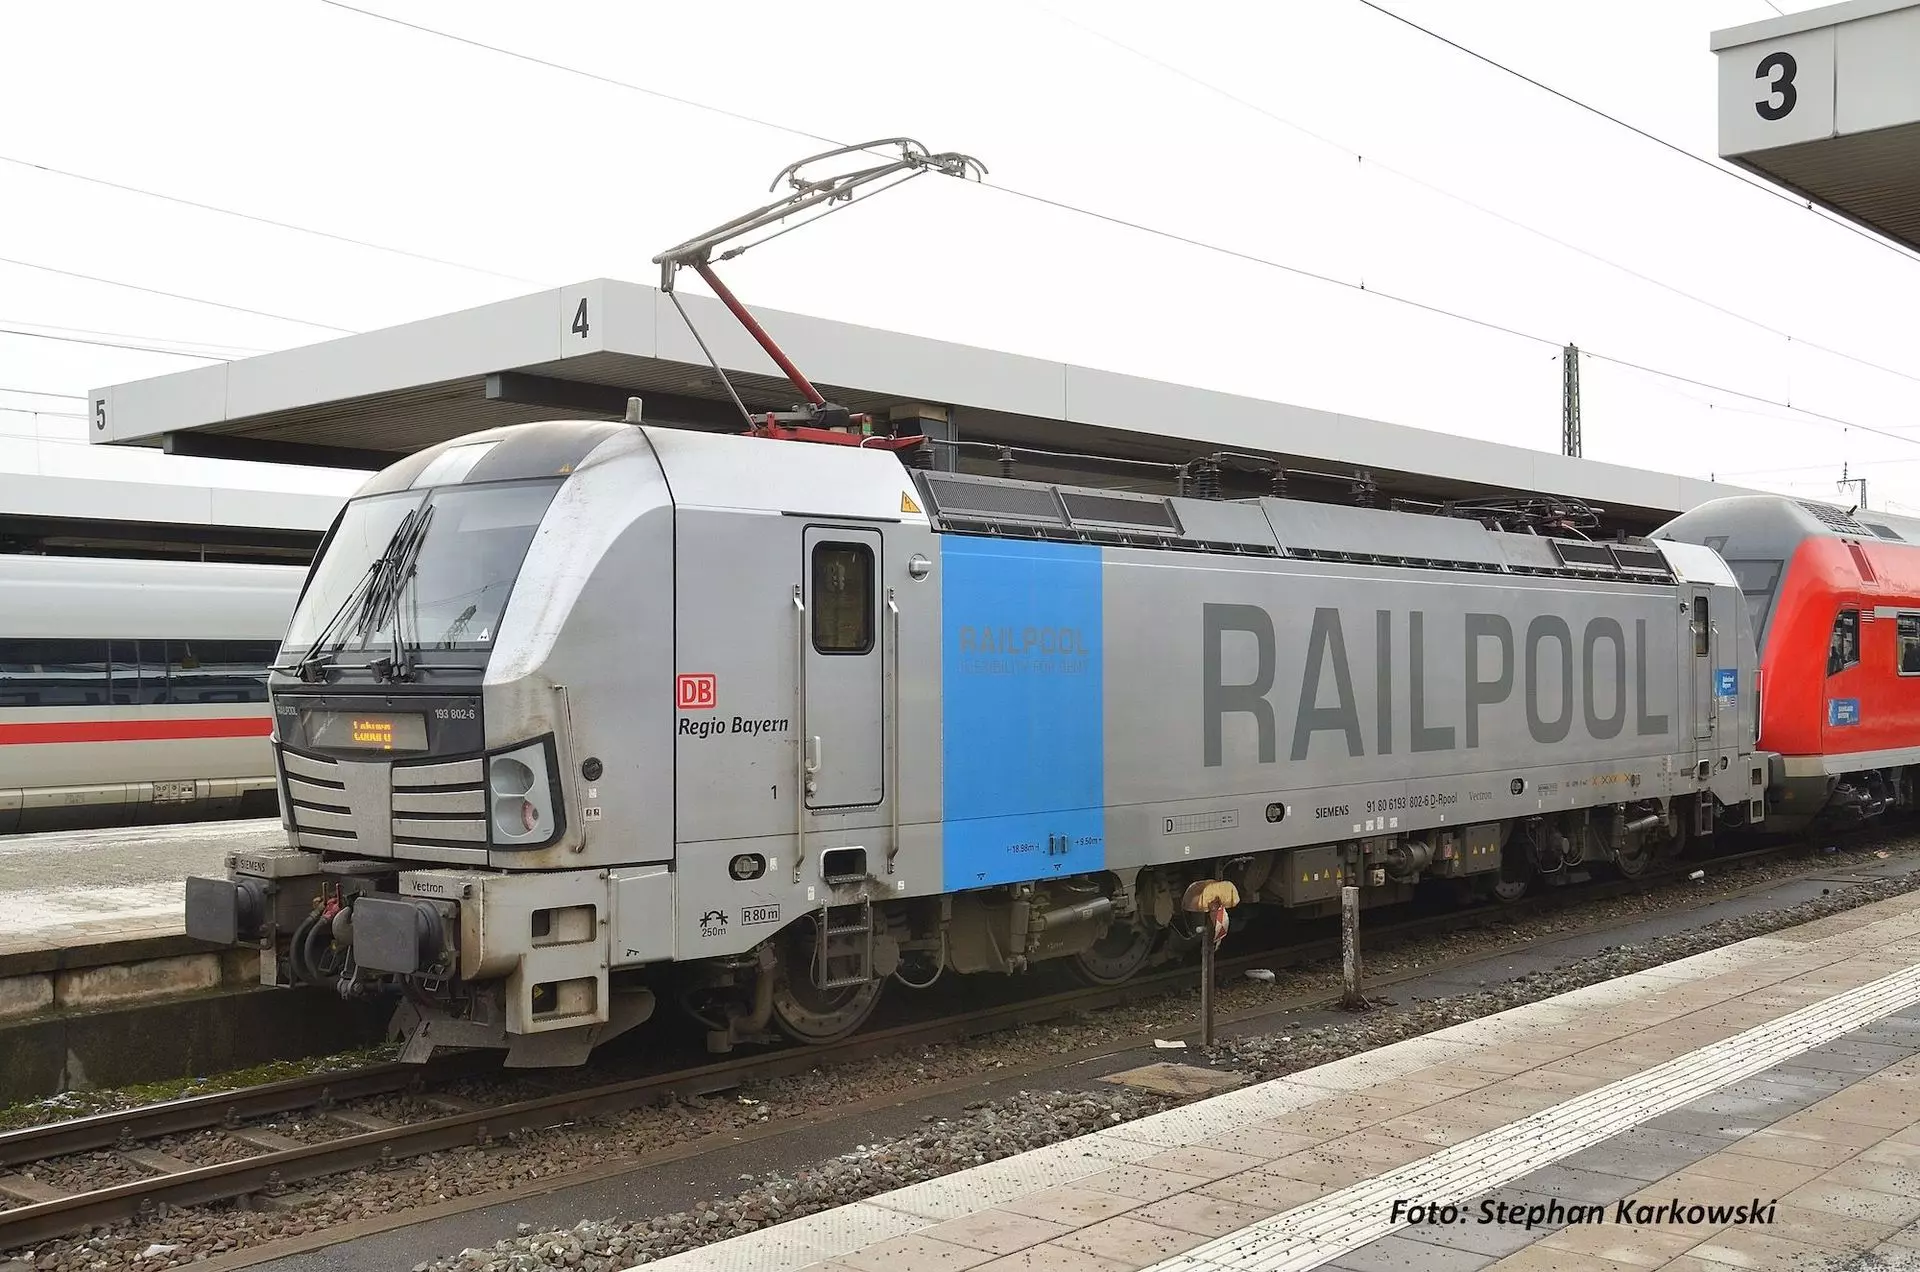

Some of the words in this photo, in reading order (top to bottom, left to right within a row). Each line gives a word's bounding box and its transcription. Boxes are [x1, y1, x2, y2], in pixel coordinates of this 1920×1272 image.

[1755, 51, 1797, 121] 3
[572, 297, 590, 339] 4
[96, 399, 106, 431] 5
[959, 624, 1090, 655] RAILPOOL
[682, 679, 712, 703] DB
[1202, 602, 1669, 768] RAILPOOL
[434, 708, 449, 719] 193
[451, 708, 476, 720] 802-6
[679, 716, 726, 739] Regio
[731, 716, 789, 737] Bayern
[771, 784, 778, 800] 1
[1315, 804, 1350, 819] SIEMENS
[1366, 800, 1376, 813] 91
[1377, 799, 1388, 812] 80
[1388, 797, 1406, 810] 6193
[1409, 795, 1429, 808] 802-6
[1166, 818, 1174, 833] D
[240, 858, 266, 873] SIEMENS
[411, 879, 444, 894] Vectron
[744, 910, 751, 922] R
[752, 908, 767, 921] 80
[702, 926, 727, 938] 250m
